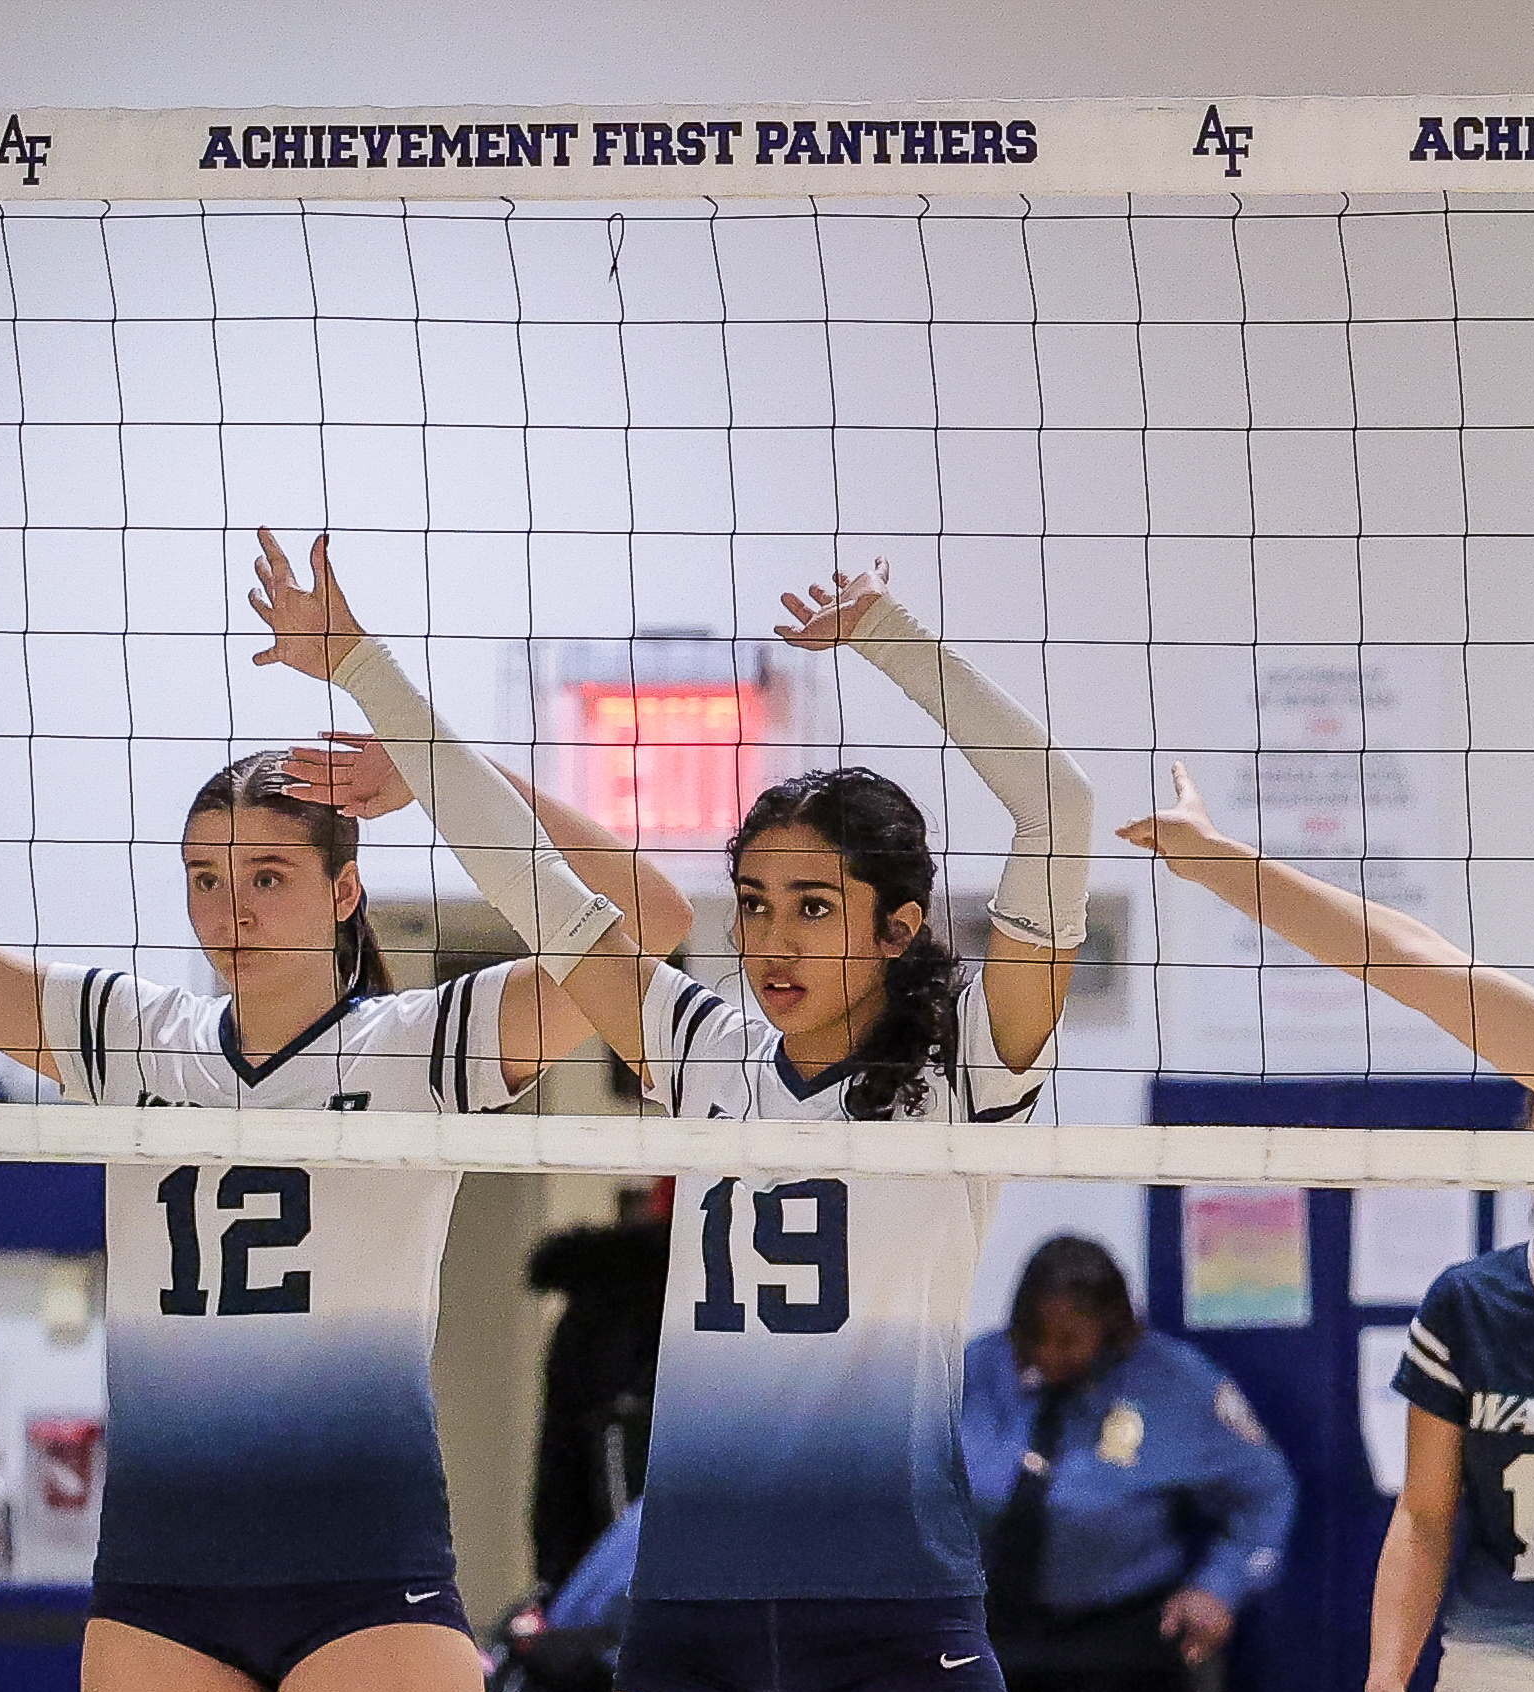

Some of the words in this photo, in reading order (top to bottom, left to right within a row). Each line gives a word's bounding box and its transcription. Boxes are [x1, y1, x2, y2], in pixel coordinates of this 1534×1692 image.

[199, 124, 578, 169] ACHIEVEMENT
[593, 122, 742, 167] FIRST
[756, 120, 1037, 165] PANTHERS
[1193, 105, 1253, 177] AF
[158, 1166, 311, 1317] 12
[694, 1177, 850, 1333] 19
